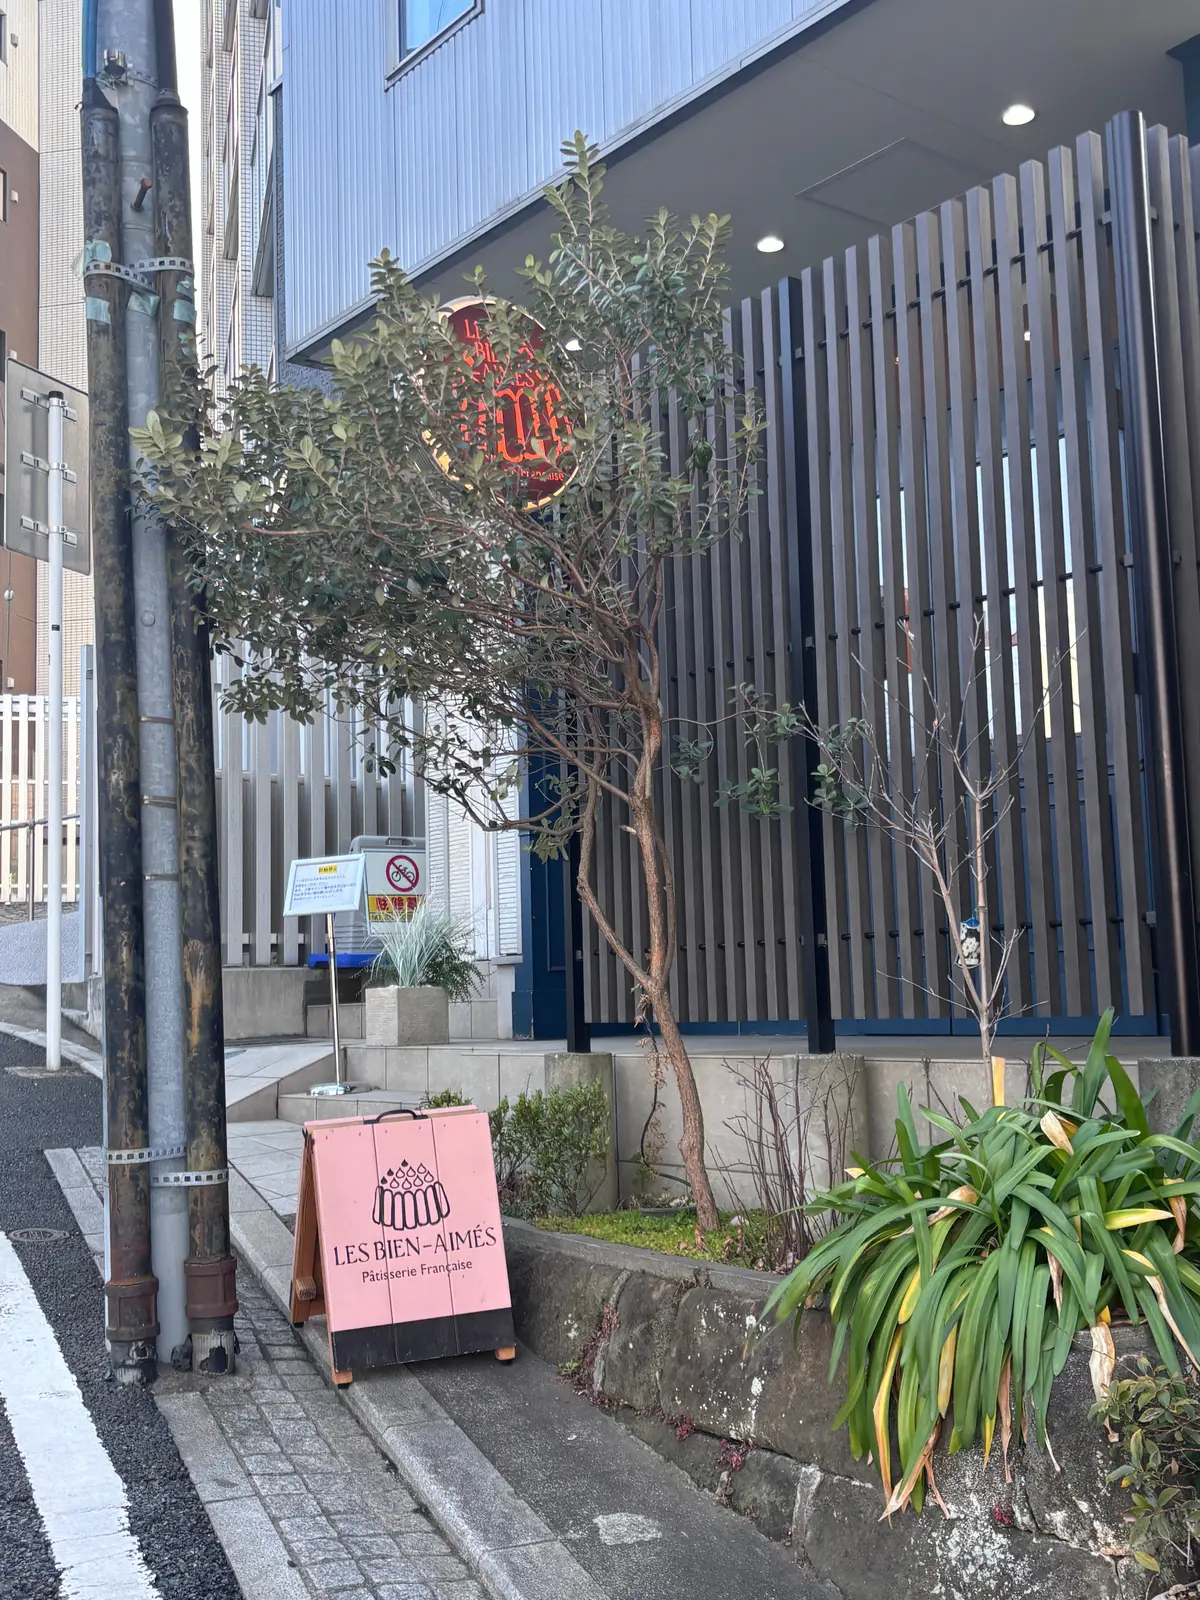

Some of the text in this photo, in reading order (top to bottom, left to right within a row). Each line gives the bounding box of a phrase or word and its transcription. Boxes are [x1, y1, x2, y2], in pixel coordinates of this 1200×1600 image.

[333, 1224, 497, 1266] LES BIEN-AIMÉS
[362, 1259, 473, 1283] Pâtisserie Française
